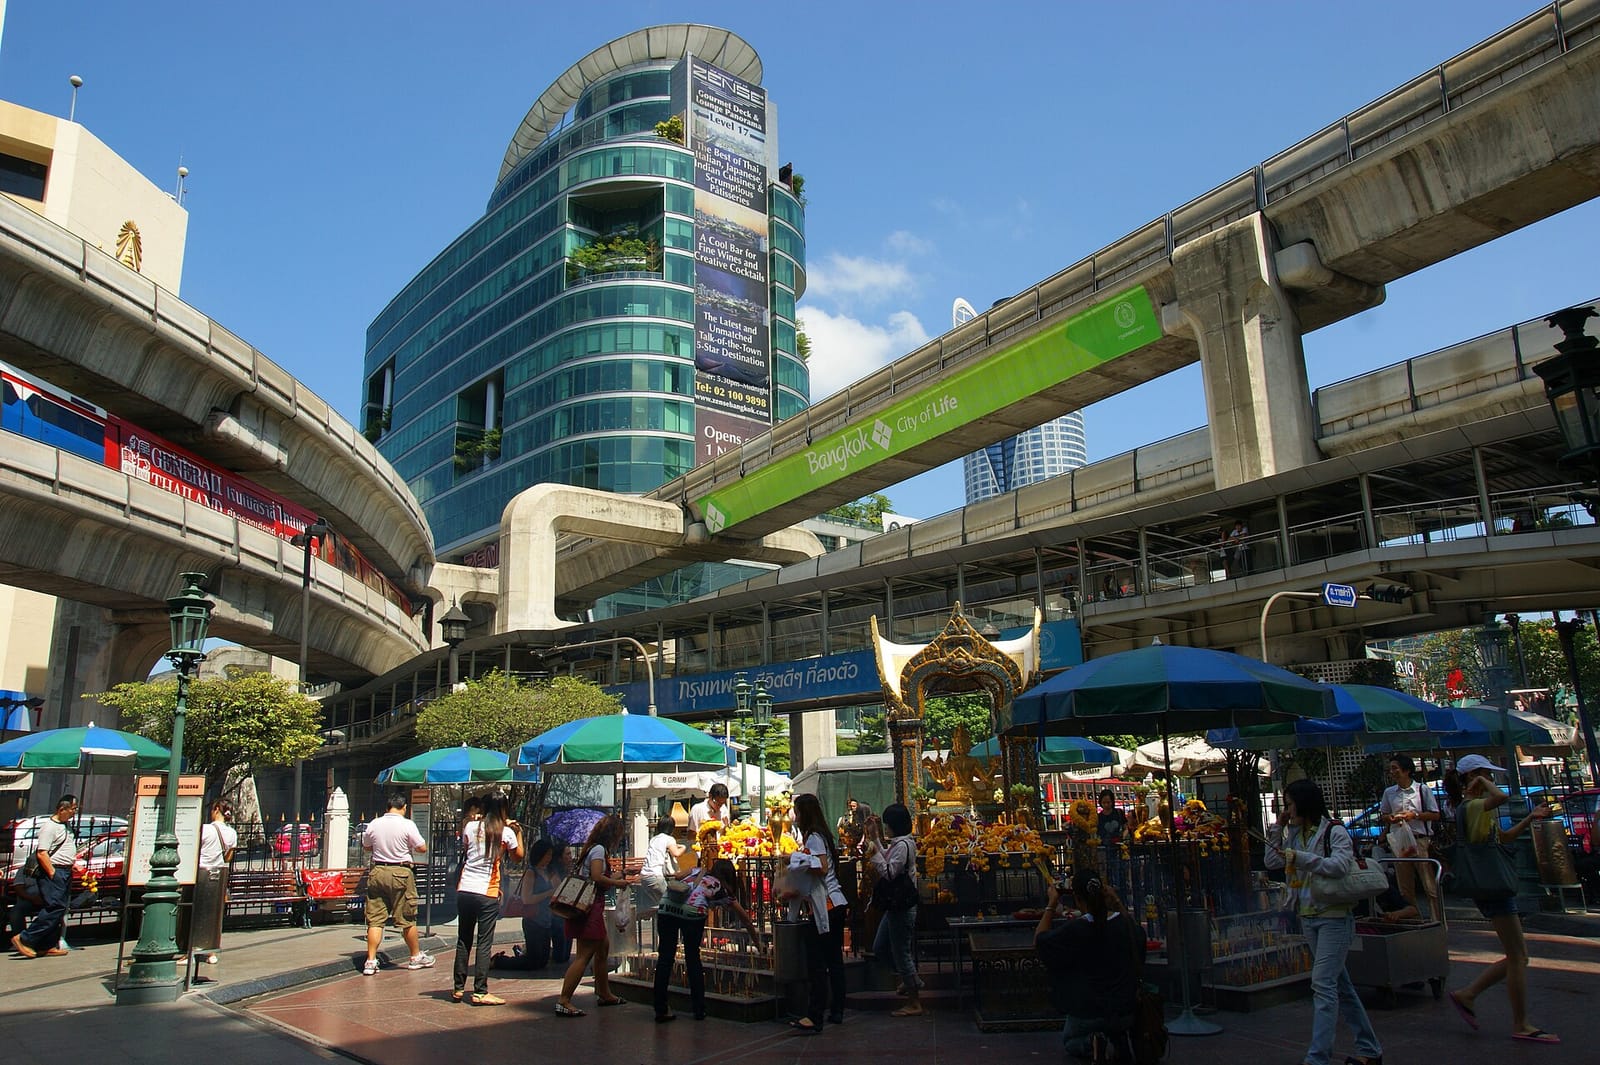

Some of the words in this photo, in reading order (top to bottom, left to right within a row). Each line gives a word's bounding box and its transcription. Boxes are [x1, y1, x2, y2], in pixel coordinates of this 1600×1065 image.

[693, 64, 764, 106] ZENSE
[696, 95, 723, 113] Lounge
[725, 109, 762, 130] Panorama
[698, 89, 732, 110] Gourmet
[733, 104, 752, 118] Deck
[710, 113, 735, 130] Level
[738, 126, 749, 136] 17
[695, 150, 724, 169] Italian,
[726, 162, 763, 185] Japanese,
[697, 141, 712, 153] The
[714, 147, 731, 162] Best
[733, 157, 742, 166] of
[743, 159, 762, 175] Thai,
[694, 158, 721, 175] Indian
[722, 170, 756, 190] Cuisines
[757, 184, 764, 194] &
[705, 172, 754, 198] Scrumptious
[698, 242, 716, 255] Fine
[717, 248, 742, 264] Wines
[743, 260, 759, 271] and
[699, 233, 707, 243] A
[708, 236, 728, 250] Cool
[730, 243, 744, 255] Bar
[745, 248, 757, 260] for
[694, 250, 728, 270] Creative
[729, 263, 765, 283] Cocktails
[703, 311, 718, 323] The
[719, 316, 742, 331] Latest
[743, 325, 757, 335] and
[708, 323, 753, 344] Unmatched
[696, 340, 720, 354] 5-Star
[721, 347, 765, 368] Destination
[698, 330, 762, 357] Talk-of-the-Town
[695, 381, 712, 394] Tel:
[713, 386, 726, 397] 02
[728, 390, 744, 402] 100
[745, 394, 767, 408] 9898
[704, 425, 742, 445] Opens
[804, 428, 873, 475] Bangkok
[896, 415, 918, 433] City
[920, 406, 931, 424] of
[932, 395, 958, 417] Life
[705, 443, 712, 456] 1
[151, 447, 223, 496] GENERALI
